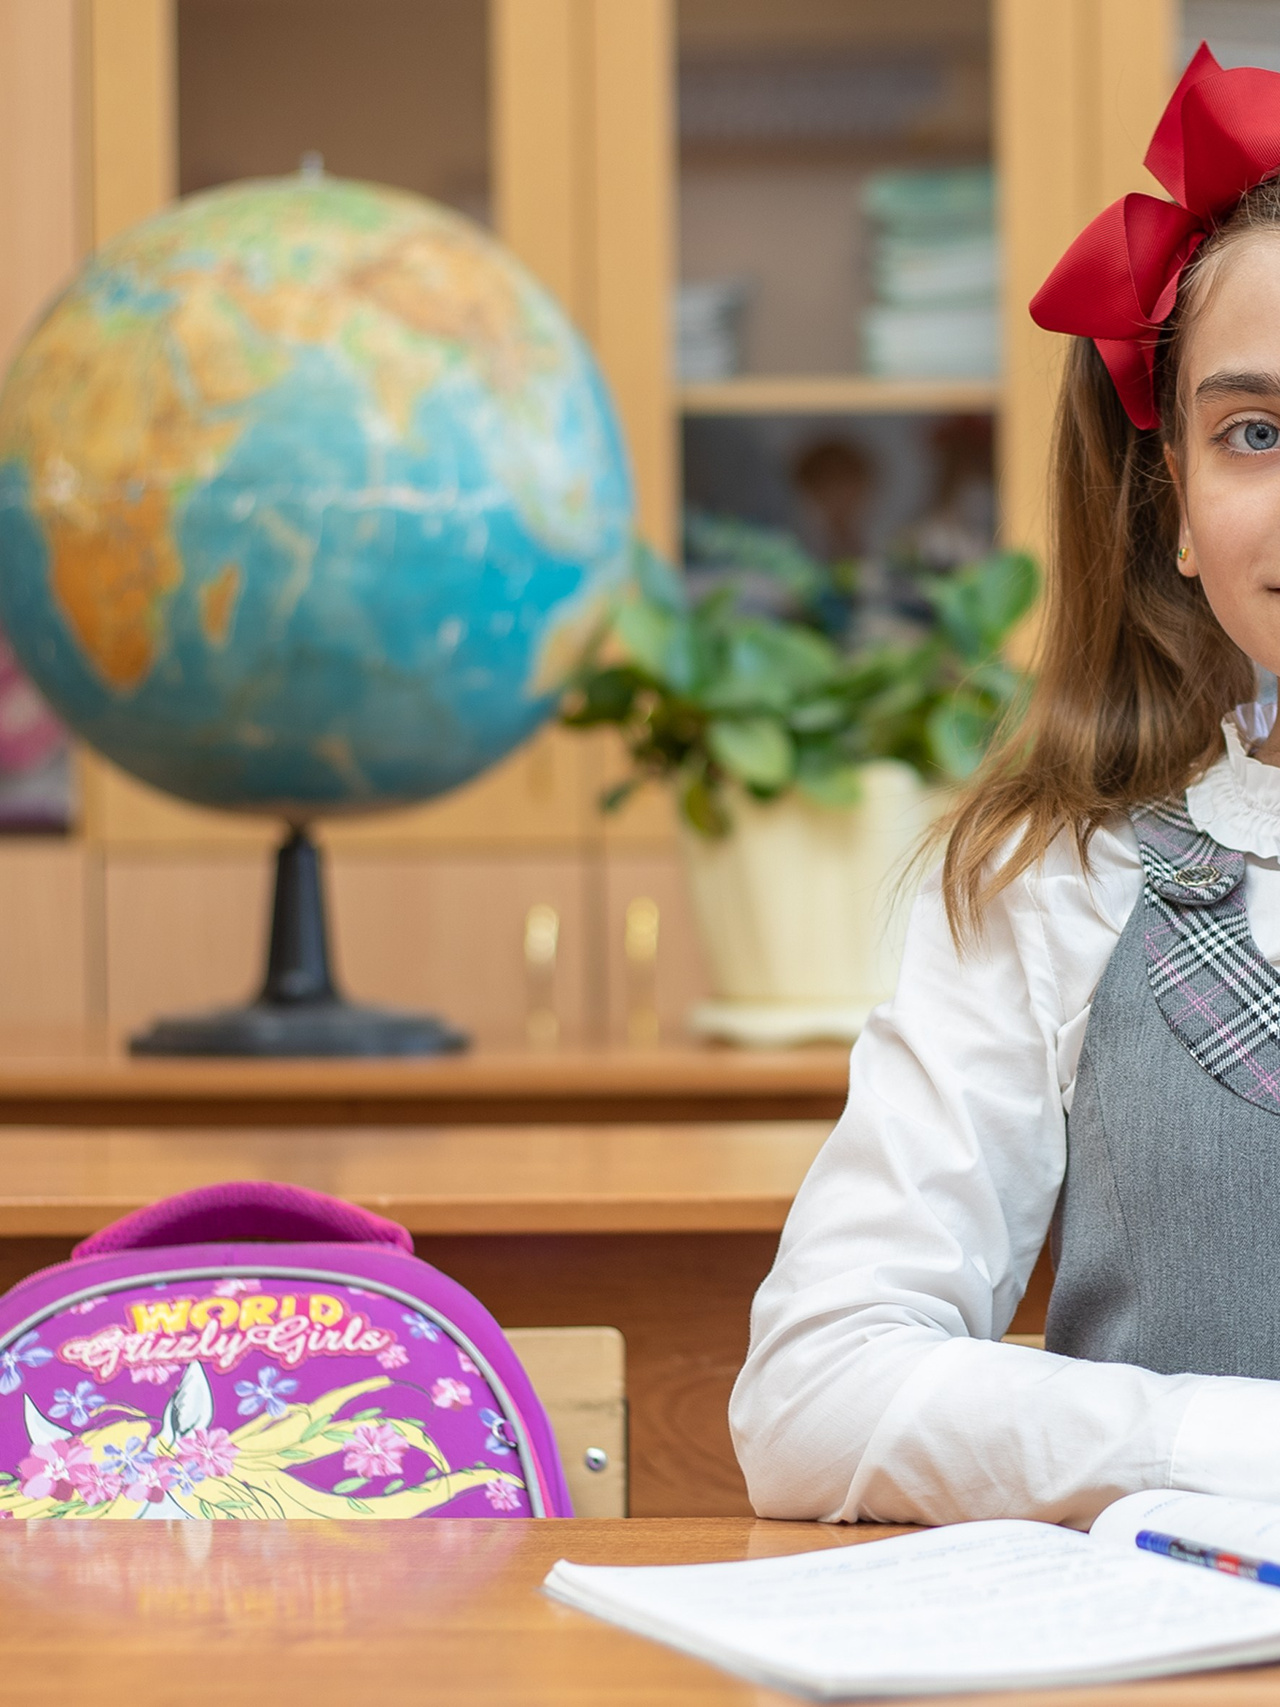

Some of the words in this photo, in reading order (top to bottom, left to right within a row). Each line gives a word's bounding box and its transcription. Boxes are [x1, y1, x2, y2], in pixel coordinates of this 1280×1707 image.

[131, 1294, 344, 1334] WORLD
[62, 1318, 248, 1378] Grizzly
[247, 1314, 391, 1364] Girls
